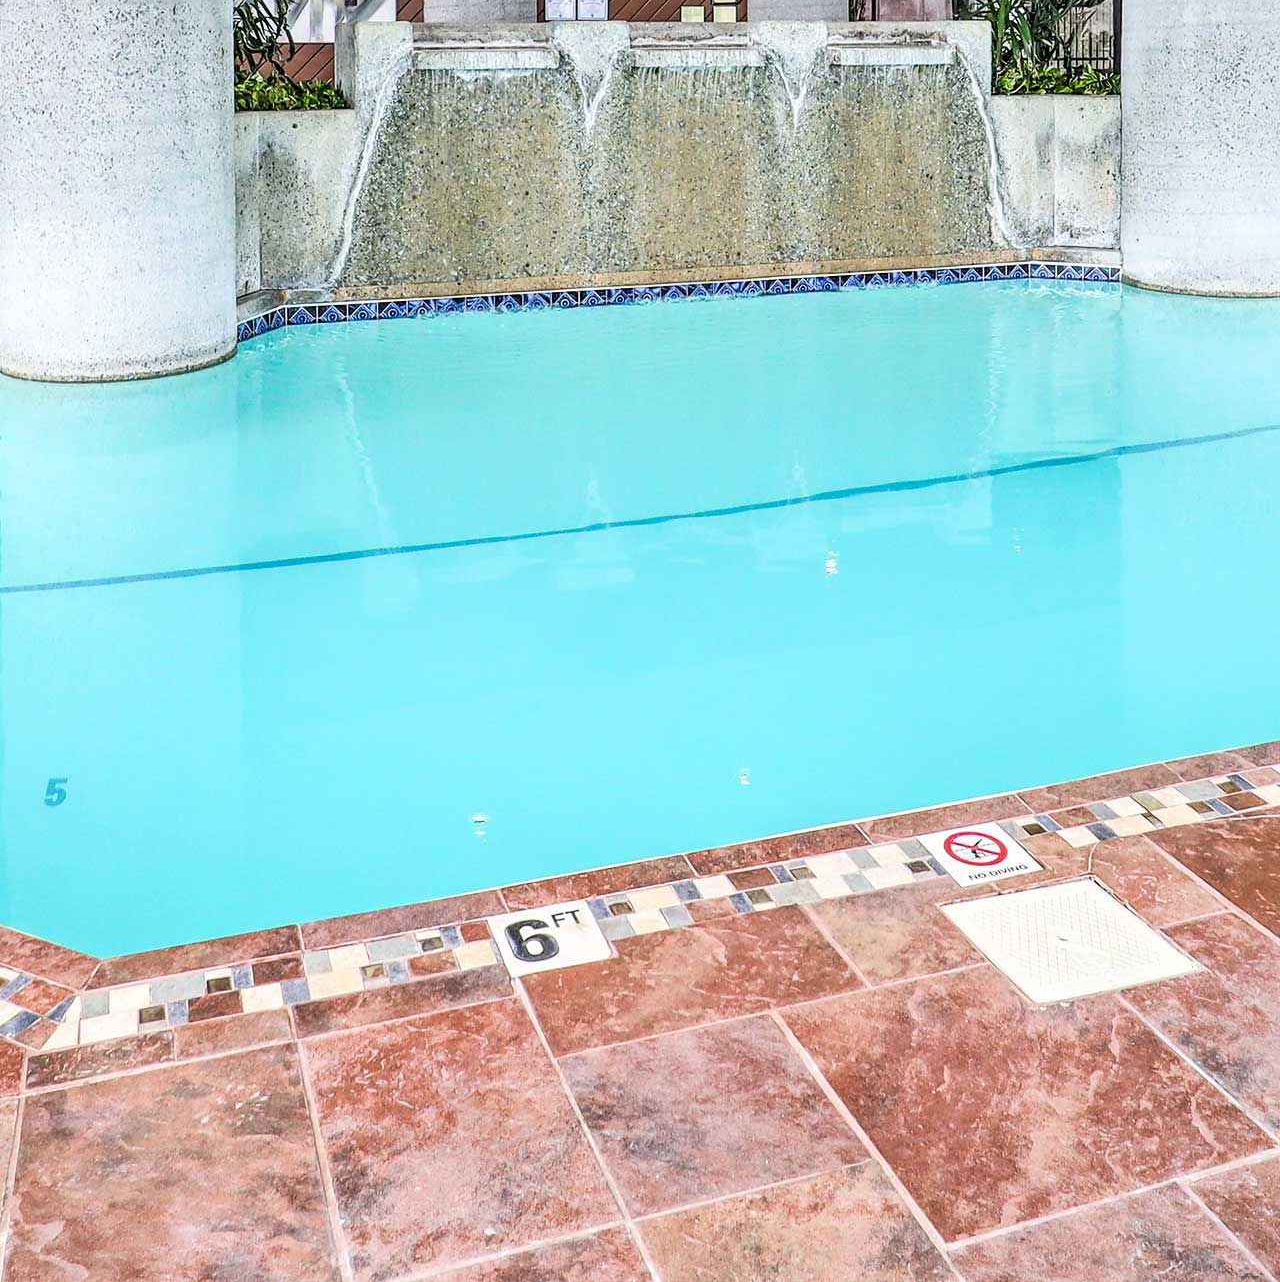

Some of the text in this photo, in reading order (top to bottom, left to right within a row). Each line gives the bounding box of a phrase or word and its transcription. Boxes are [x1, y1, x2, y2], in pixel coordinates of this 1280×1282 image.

[43, 777, 69, 807] 5
[968, 864, 1029, 881] NO DIVING
[504, 909, 581, 963] 6 FT
